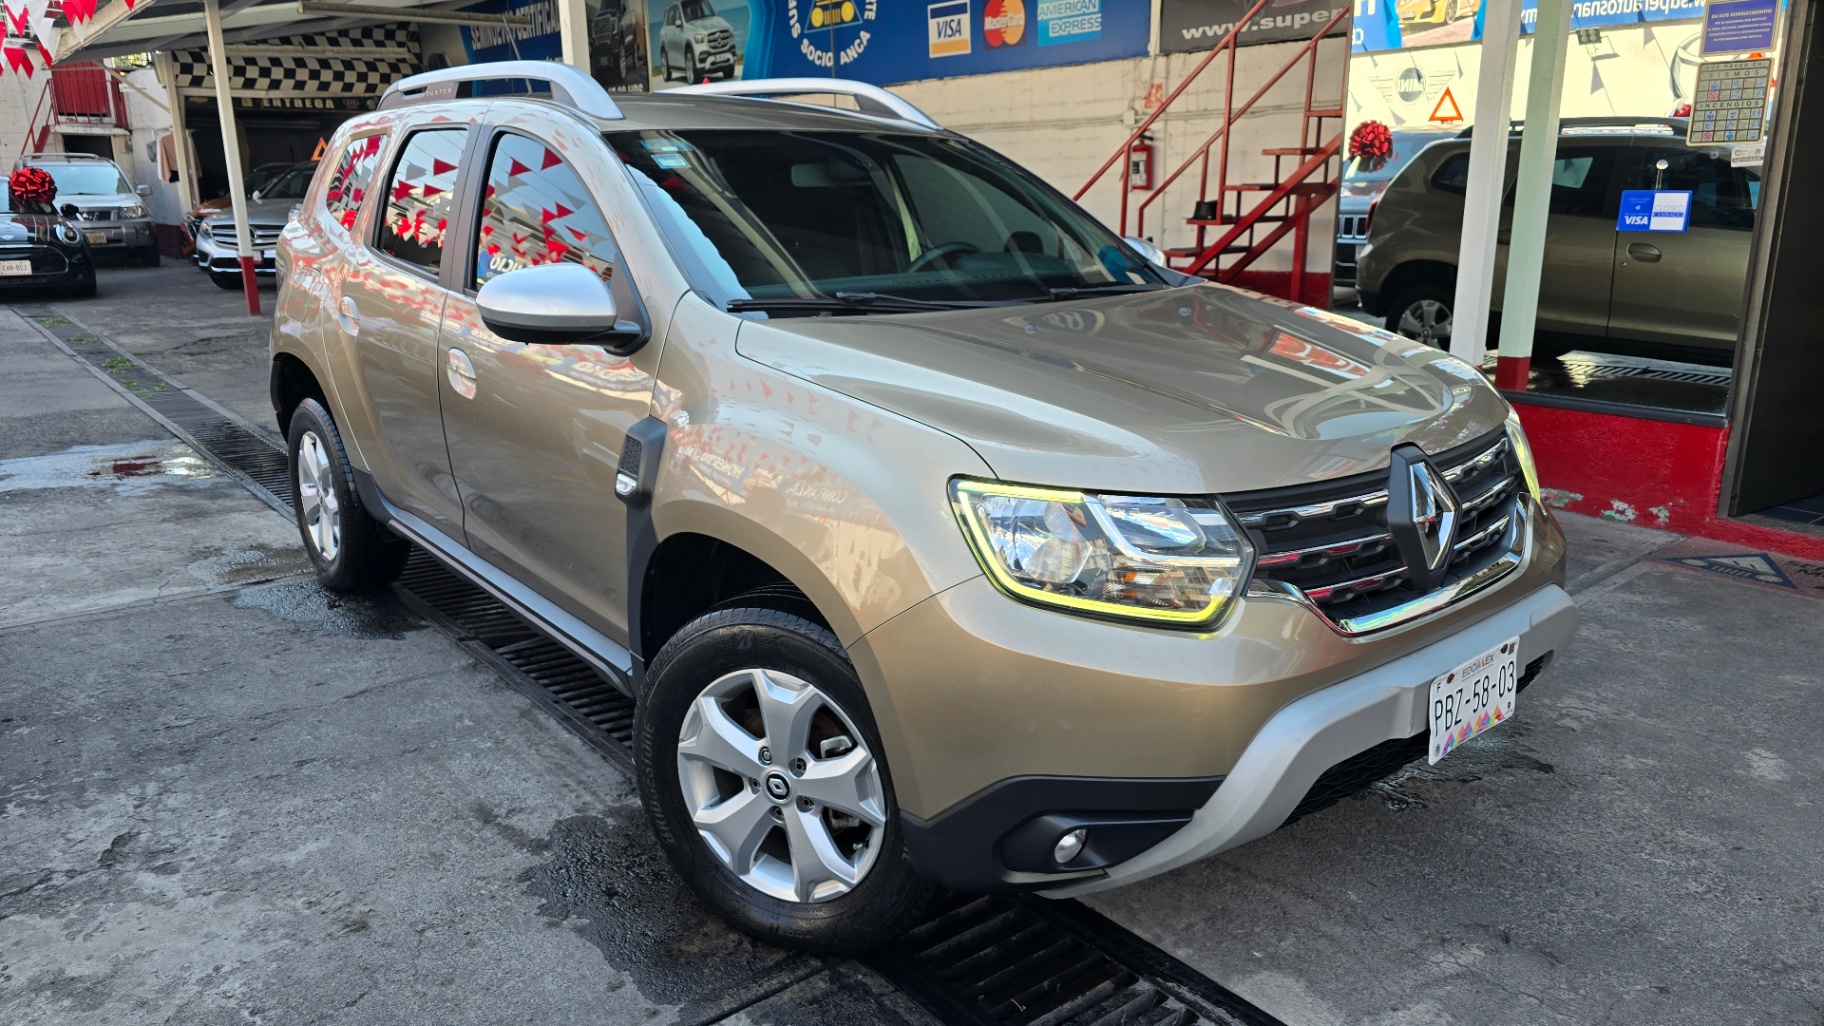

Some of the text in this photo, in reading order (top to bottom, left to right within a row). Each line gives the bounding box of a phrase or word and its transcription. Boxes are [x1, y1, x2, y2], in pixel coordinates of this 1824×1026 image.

[1038, 0, 1097, 17] AMERICAN
[936, 18, 962, 39] VISA
[984, 14, 1024, 30] MasterCard
[1051, 16, 1101, 34] EXPRESS
[801, 30, 871, 67] SOCIO ANCA
[1708, 70, 1760, 79] SISMOS
[426, 88, 452, 97] DUSTER
[262, 98, 335, 109] ENTREGA
[1700, 100, 1759, 109] INCENDIOS
[1654, 204, 1685, 212] CLOSED
[1624, 215, 1648, 226] VISA
[1434, 660, 1515, 738] PBZ-58-03
